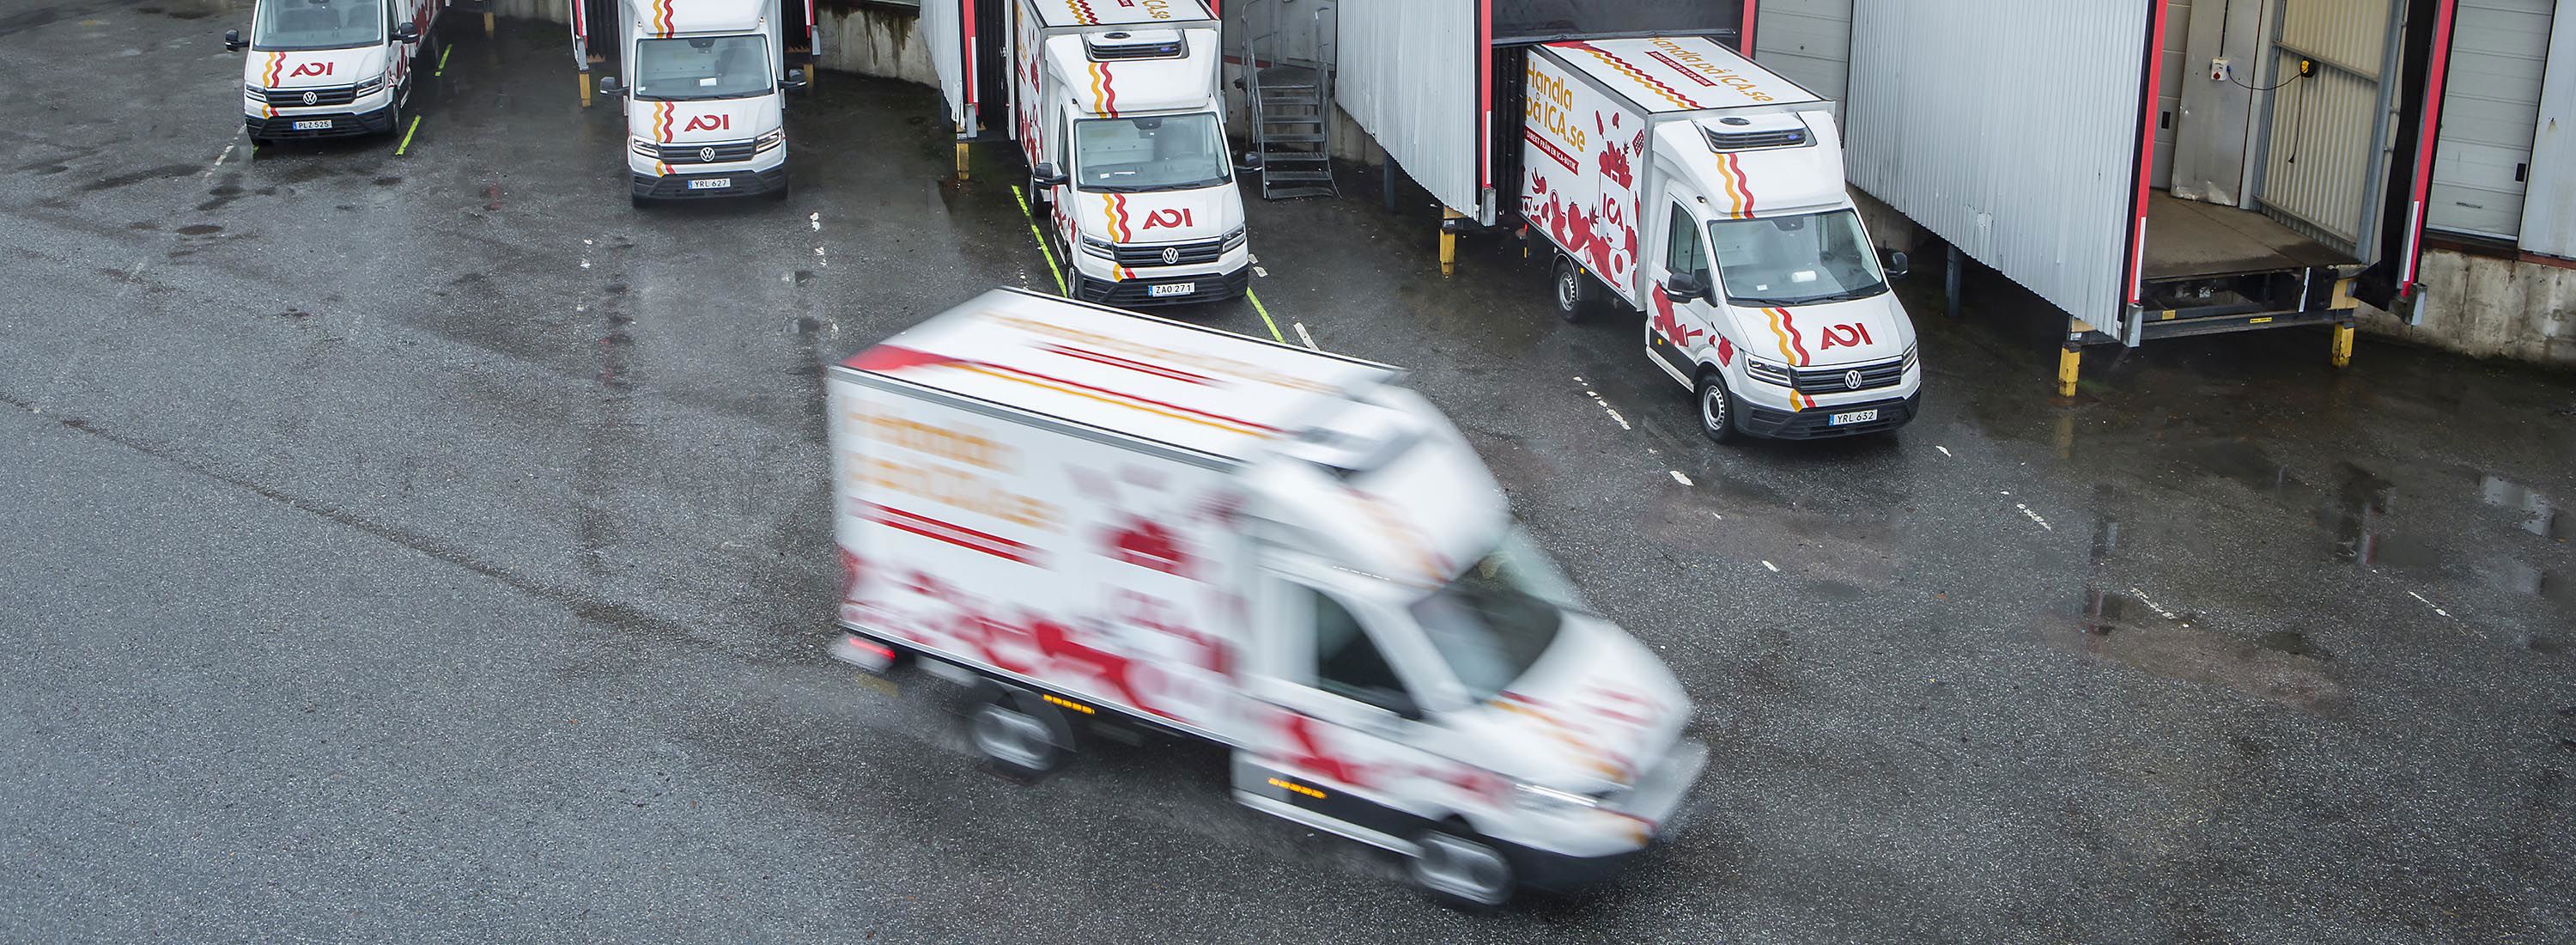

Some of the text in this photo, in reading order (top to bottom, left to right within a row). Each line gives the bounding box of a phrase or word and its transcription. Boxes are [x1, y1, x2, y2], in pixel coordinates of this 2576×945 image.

[1526, 58, 1572, 112] Handla
[1686, 63, 1732, 74] på
[1714, 75, 1774, 101] ICA.se
[1525, 92, 1586, 152] på ICA.se
[1602, 192, 1624, 232] ICA
[1175, 284, 1191, 293] 271
[1838, 412, 1874, 424] YRL 632
